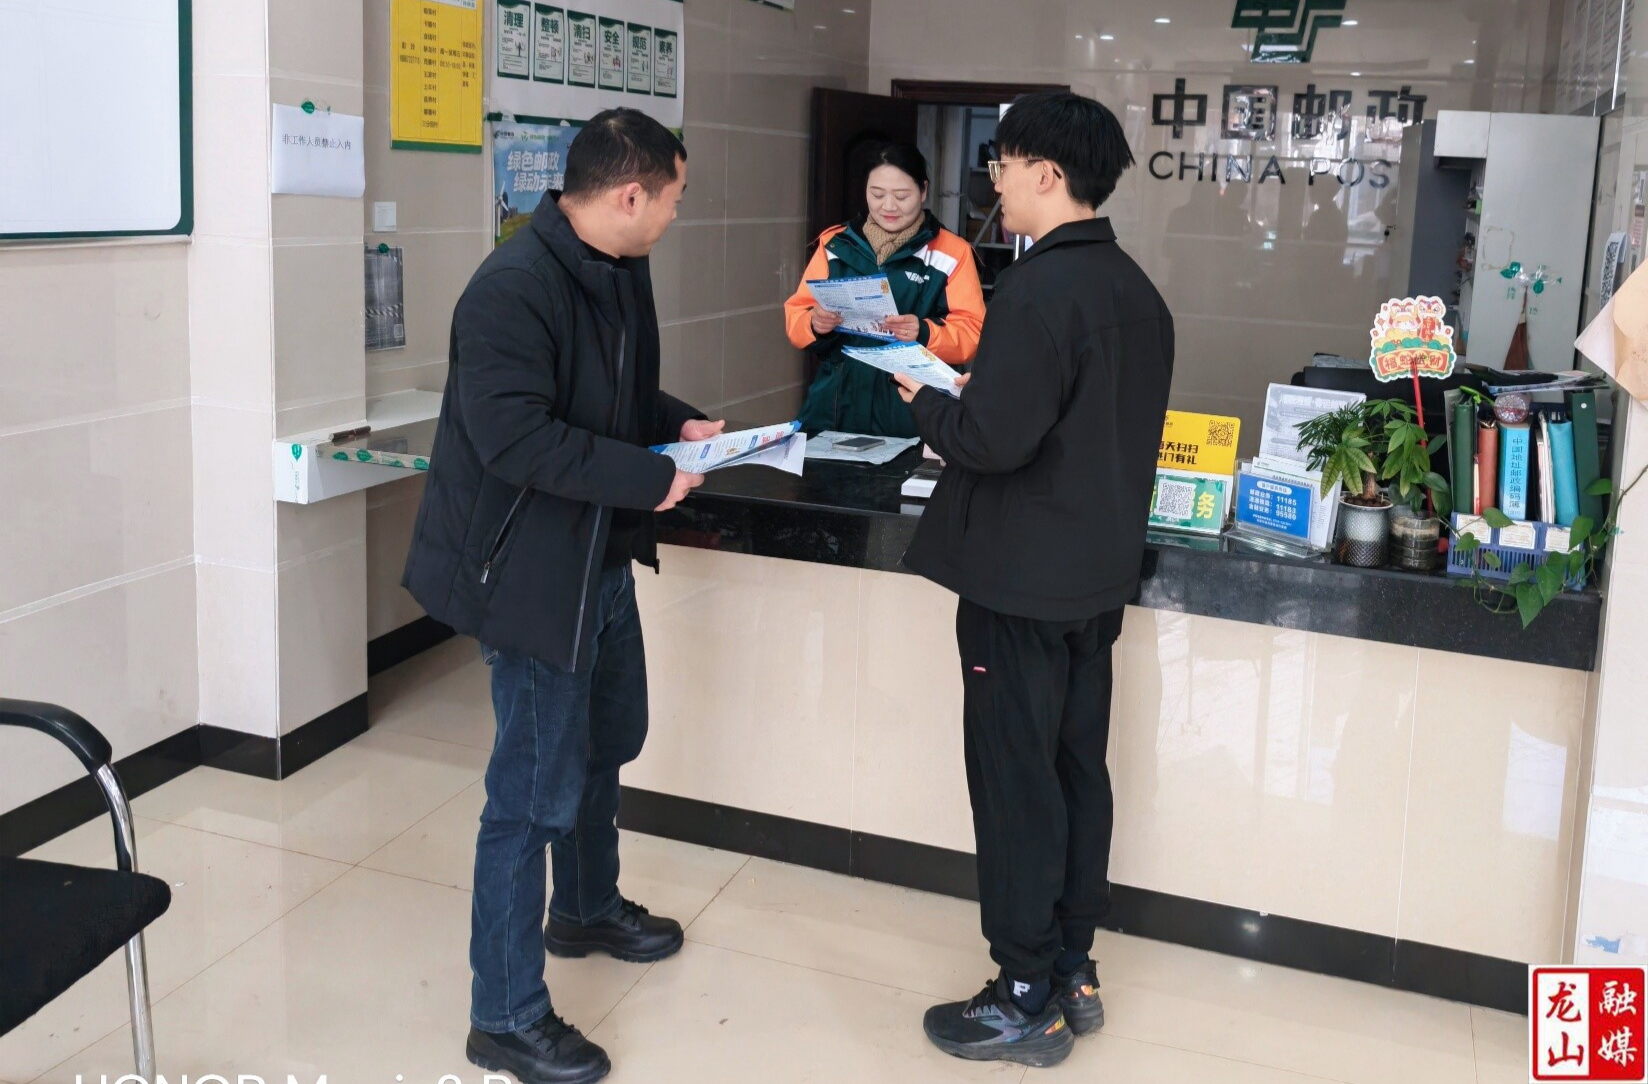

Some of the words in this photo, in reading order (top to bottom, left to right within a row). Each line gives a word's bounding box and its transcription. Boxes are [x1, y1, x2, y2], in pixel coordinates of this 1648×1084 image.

[503, 11, 524, 28] 清理
[540, 17, 559, 35] 整顿
[573, 24, 591, 41] 清扫
[604, 30, 620, 46] 安全
[632, 36, 647, 51] 规范
[658, 40, 673, 54] 素养
[1152, 78, 1427, 145] 中国邮政
[282, 134, 351, 150] 非工作人员禁止入内
[507, 150, 560, 171] 绿色邮政
[1148, 150, 1286, 185] CHINA
[1308, 156, 1392, 190] POS
[513, 172, 564, 192] 绿动未来
[1275, 503, 1297, 514] 11183
[1276, 495, 1297, 506] 11185
[1275, 509, 1297, 521] 95580
